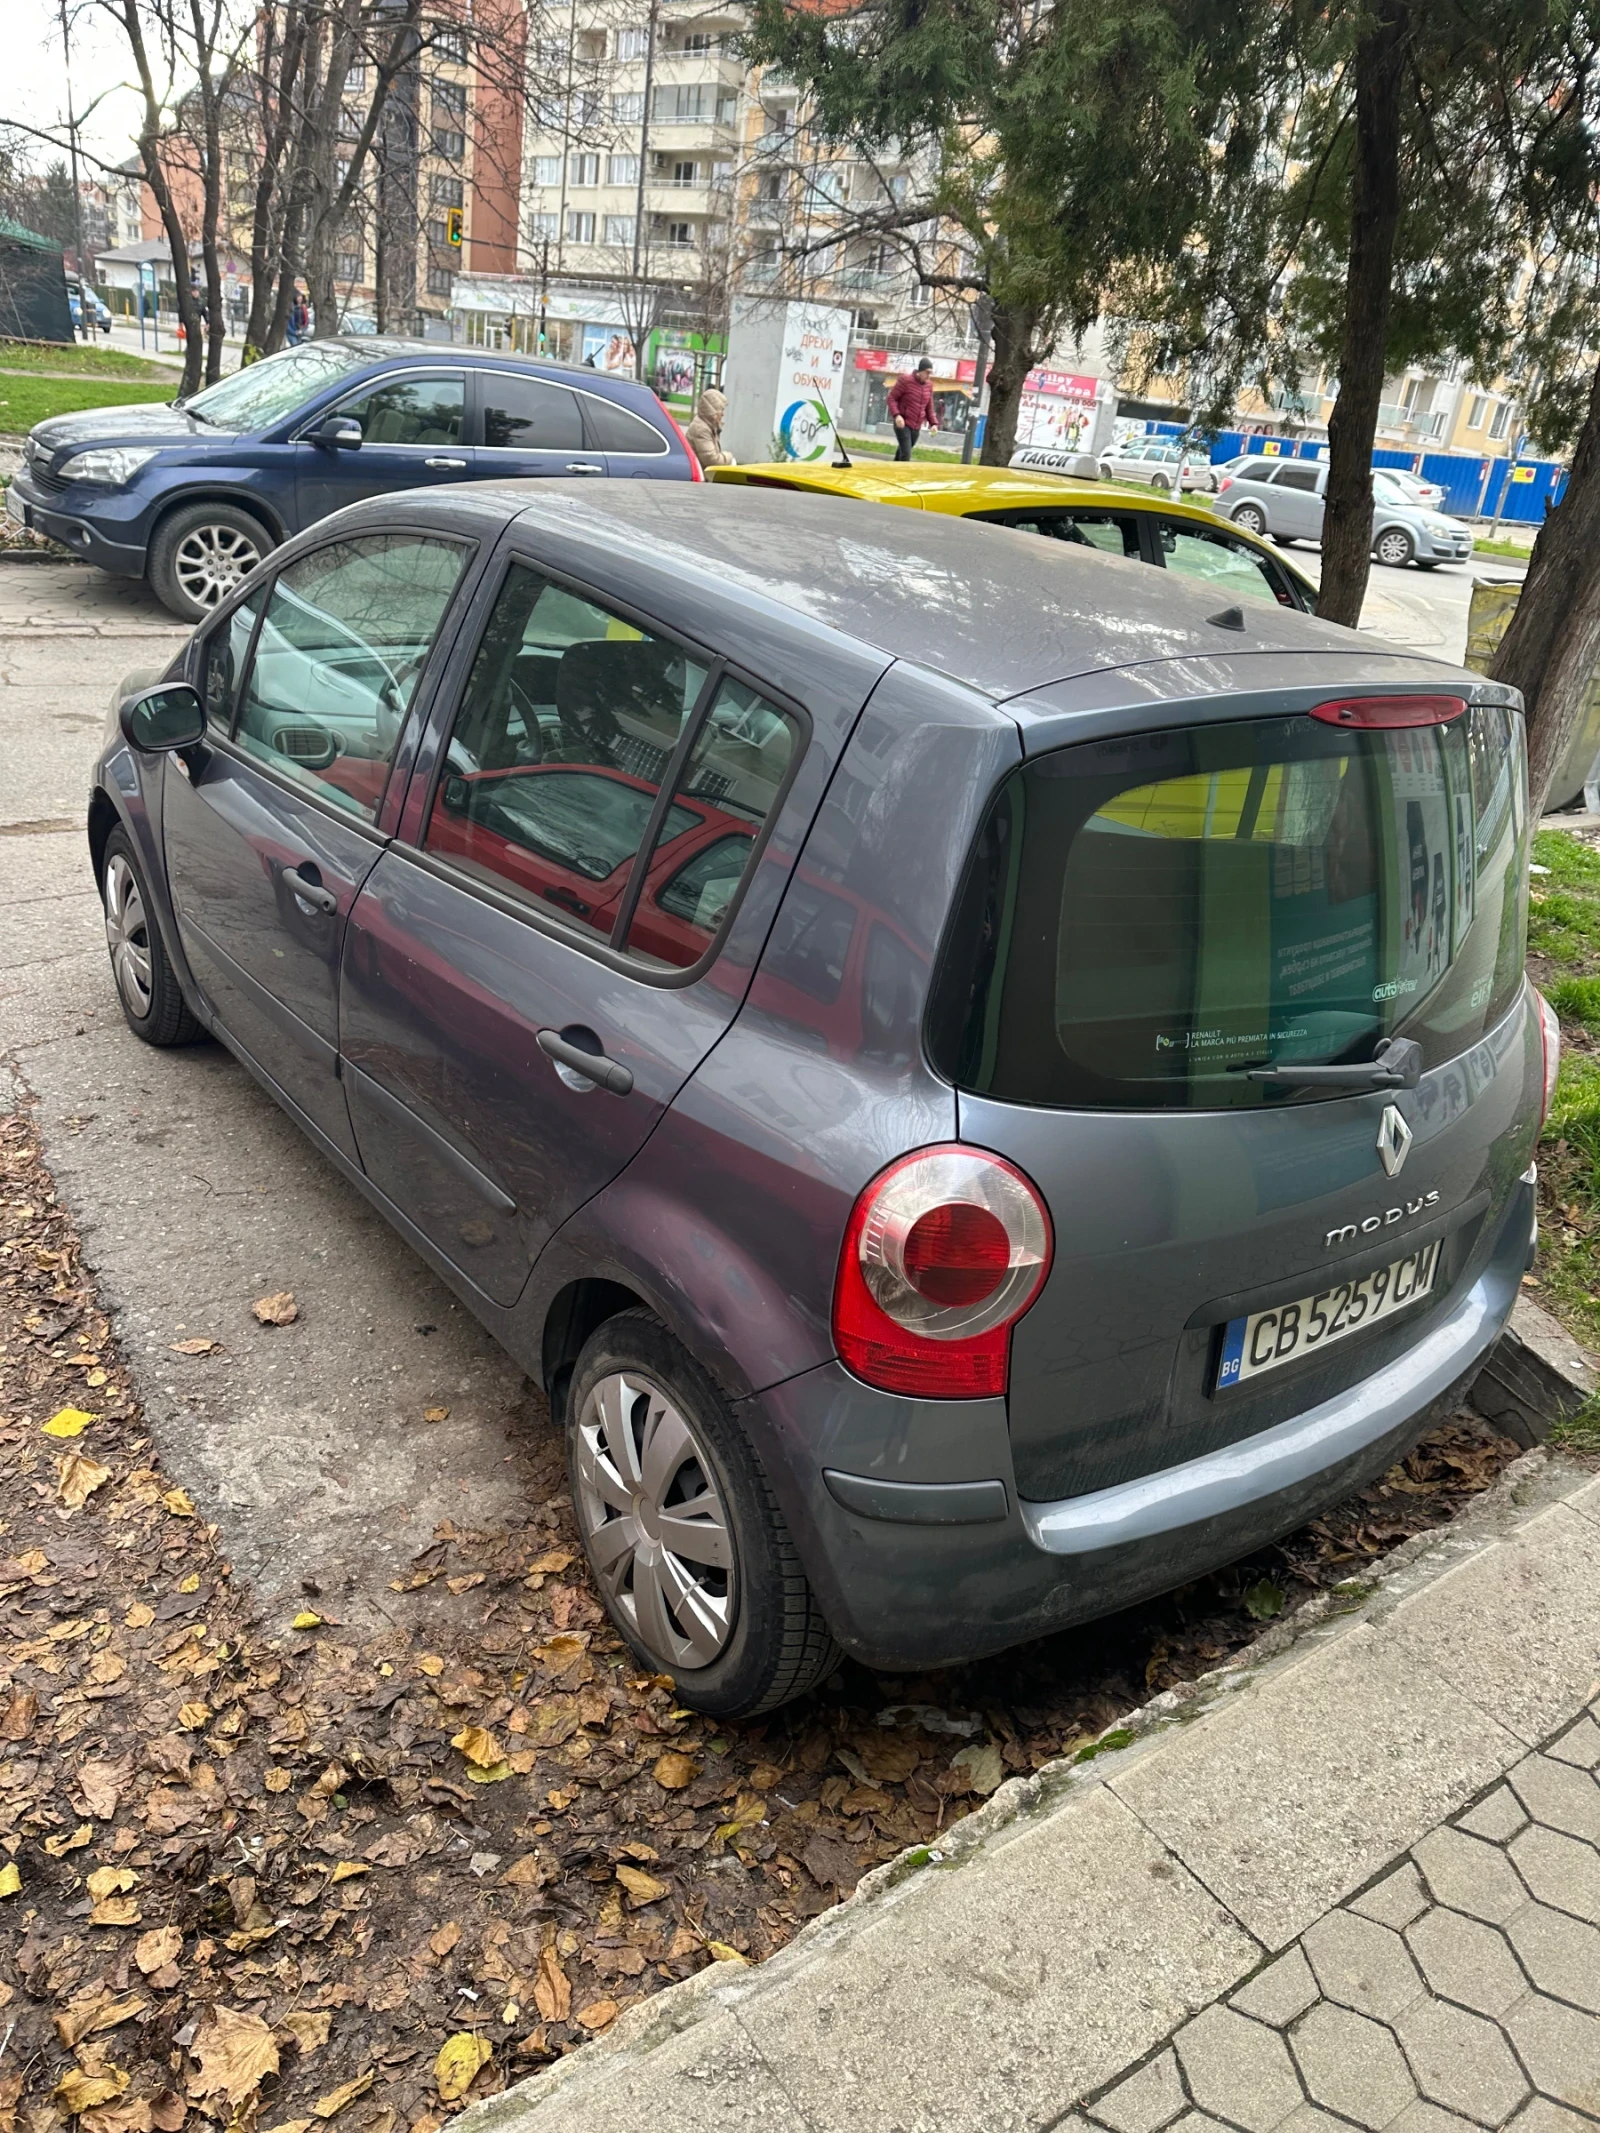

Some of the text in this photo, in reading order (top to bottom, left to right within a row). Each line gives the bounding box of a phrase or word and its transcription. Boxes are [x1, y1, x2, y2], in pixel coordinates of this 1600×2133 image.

[800, 334, 834, 350] ДРЕХИ
[811, 356, 819, 368] И
[793, 372, 832, 390] ОБУВКИ
[1057, 384, 1092, 396] Area
[1020, 452, 1070, 468] ТАКСИ
[1191, 1030, 1221, 1040] RENAULT
[1201, 1038, 1224, 1047] MARCA
[1238, 1034, 1268, 1043] PREMIATA
[1269, 1032, 1276, 1040] IN
[1277, 1029, 1308, 1039] SICUREZZA
[1306, 1266, 1391, 1344] 5259
[1221, 1358, 1240, 1378] BG
